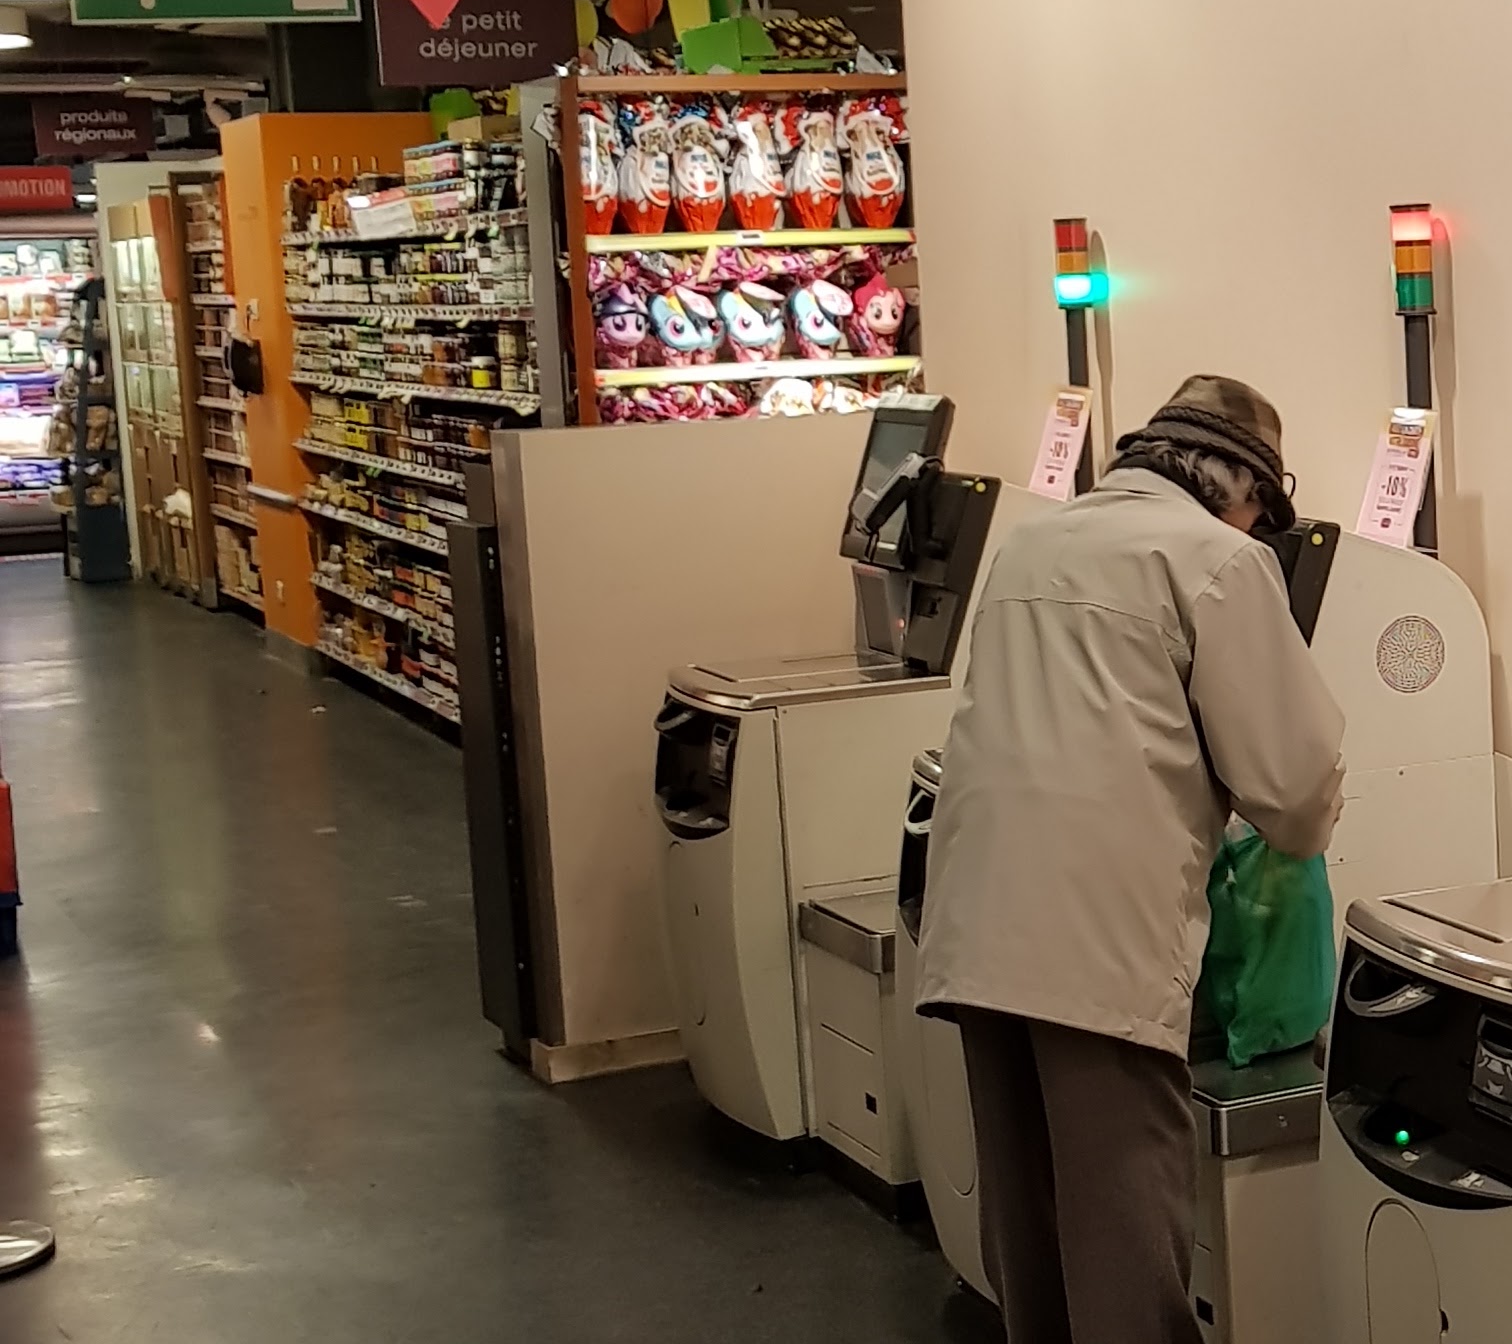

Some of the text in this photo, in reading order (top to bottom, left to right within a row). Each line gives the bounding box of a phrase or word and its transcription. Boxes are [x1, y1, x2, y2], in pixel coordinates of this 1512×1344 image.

[461, 10, 523, 34] petit
[418, 37, 539, 64] déjeuner
[60, 109, 129, 126] produits
[54, 127, 137, 145] régionaux
[0, 178, 66, 198] MOTION
